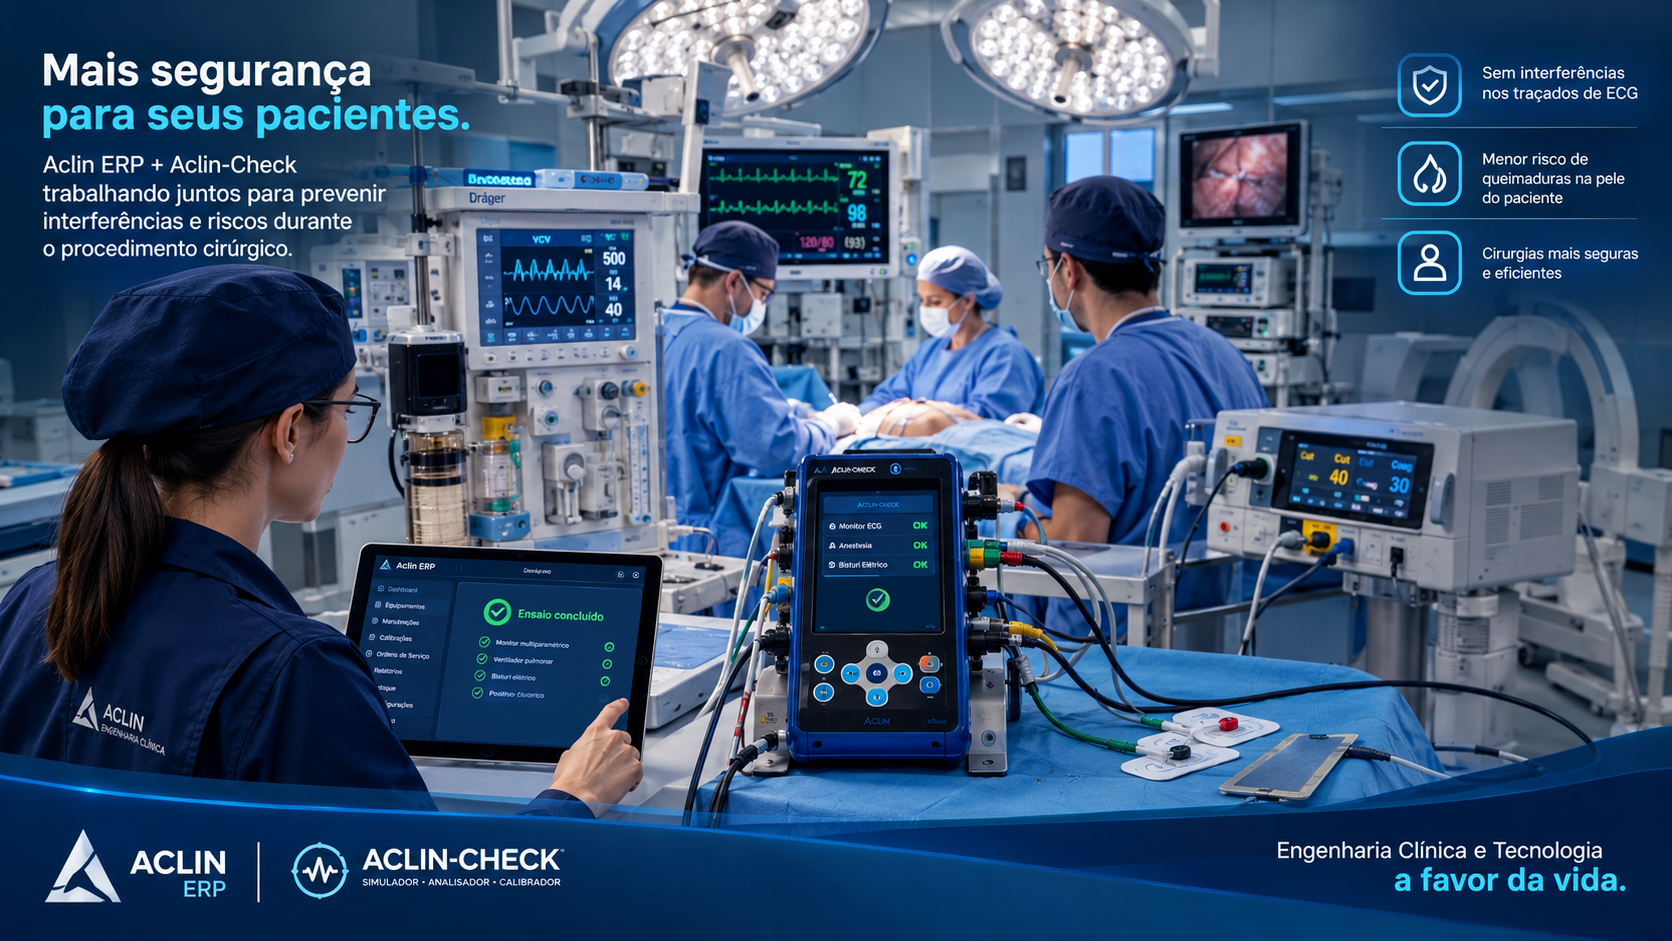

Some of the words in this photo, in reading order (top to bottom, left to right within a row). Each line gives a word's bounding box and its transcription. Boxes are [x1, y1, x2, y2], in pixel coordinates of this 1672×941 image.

[847, 170, 867, 189] 72
[847, 203, 867, 222] 98
[603, 252, 626, 266] 500
[605, 276, 621, 291] 14
[605, 302, 623, 317] 40
[1334, 453, 1351, 465] Cut
[1329, 468, 1349, 486] 40
[1389, 476, 1410, 494] 30
[838, 522, 865, 530] Monitor
[866, 522, 882, 530] ECG
[912, 521, 928, 530] OK
[912, 540, 928, 550] OK
[396, 561, 417, 571] Aclin
[418, 562, 436, 571] ERP
[912, 560, 928, 569] OK
[518, 608, 552, 620] Ensaio
[102, 703, 145, 733] ACLIN
